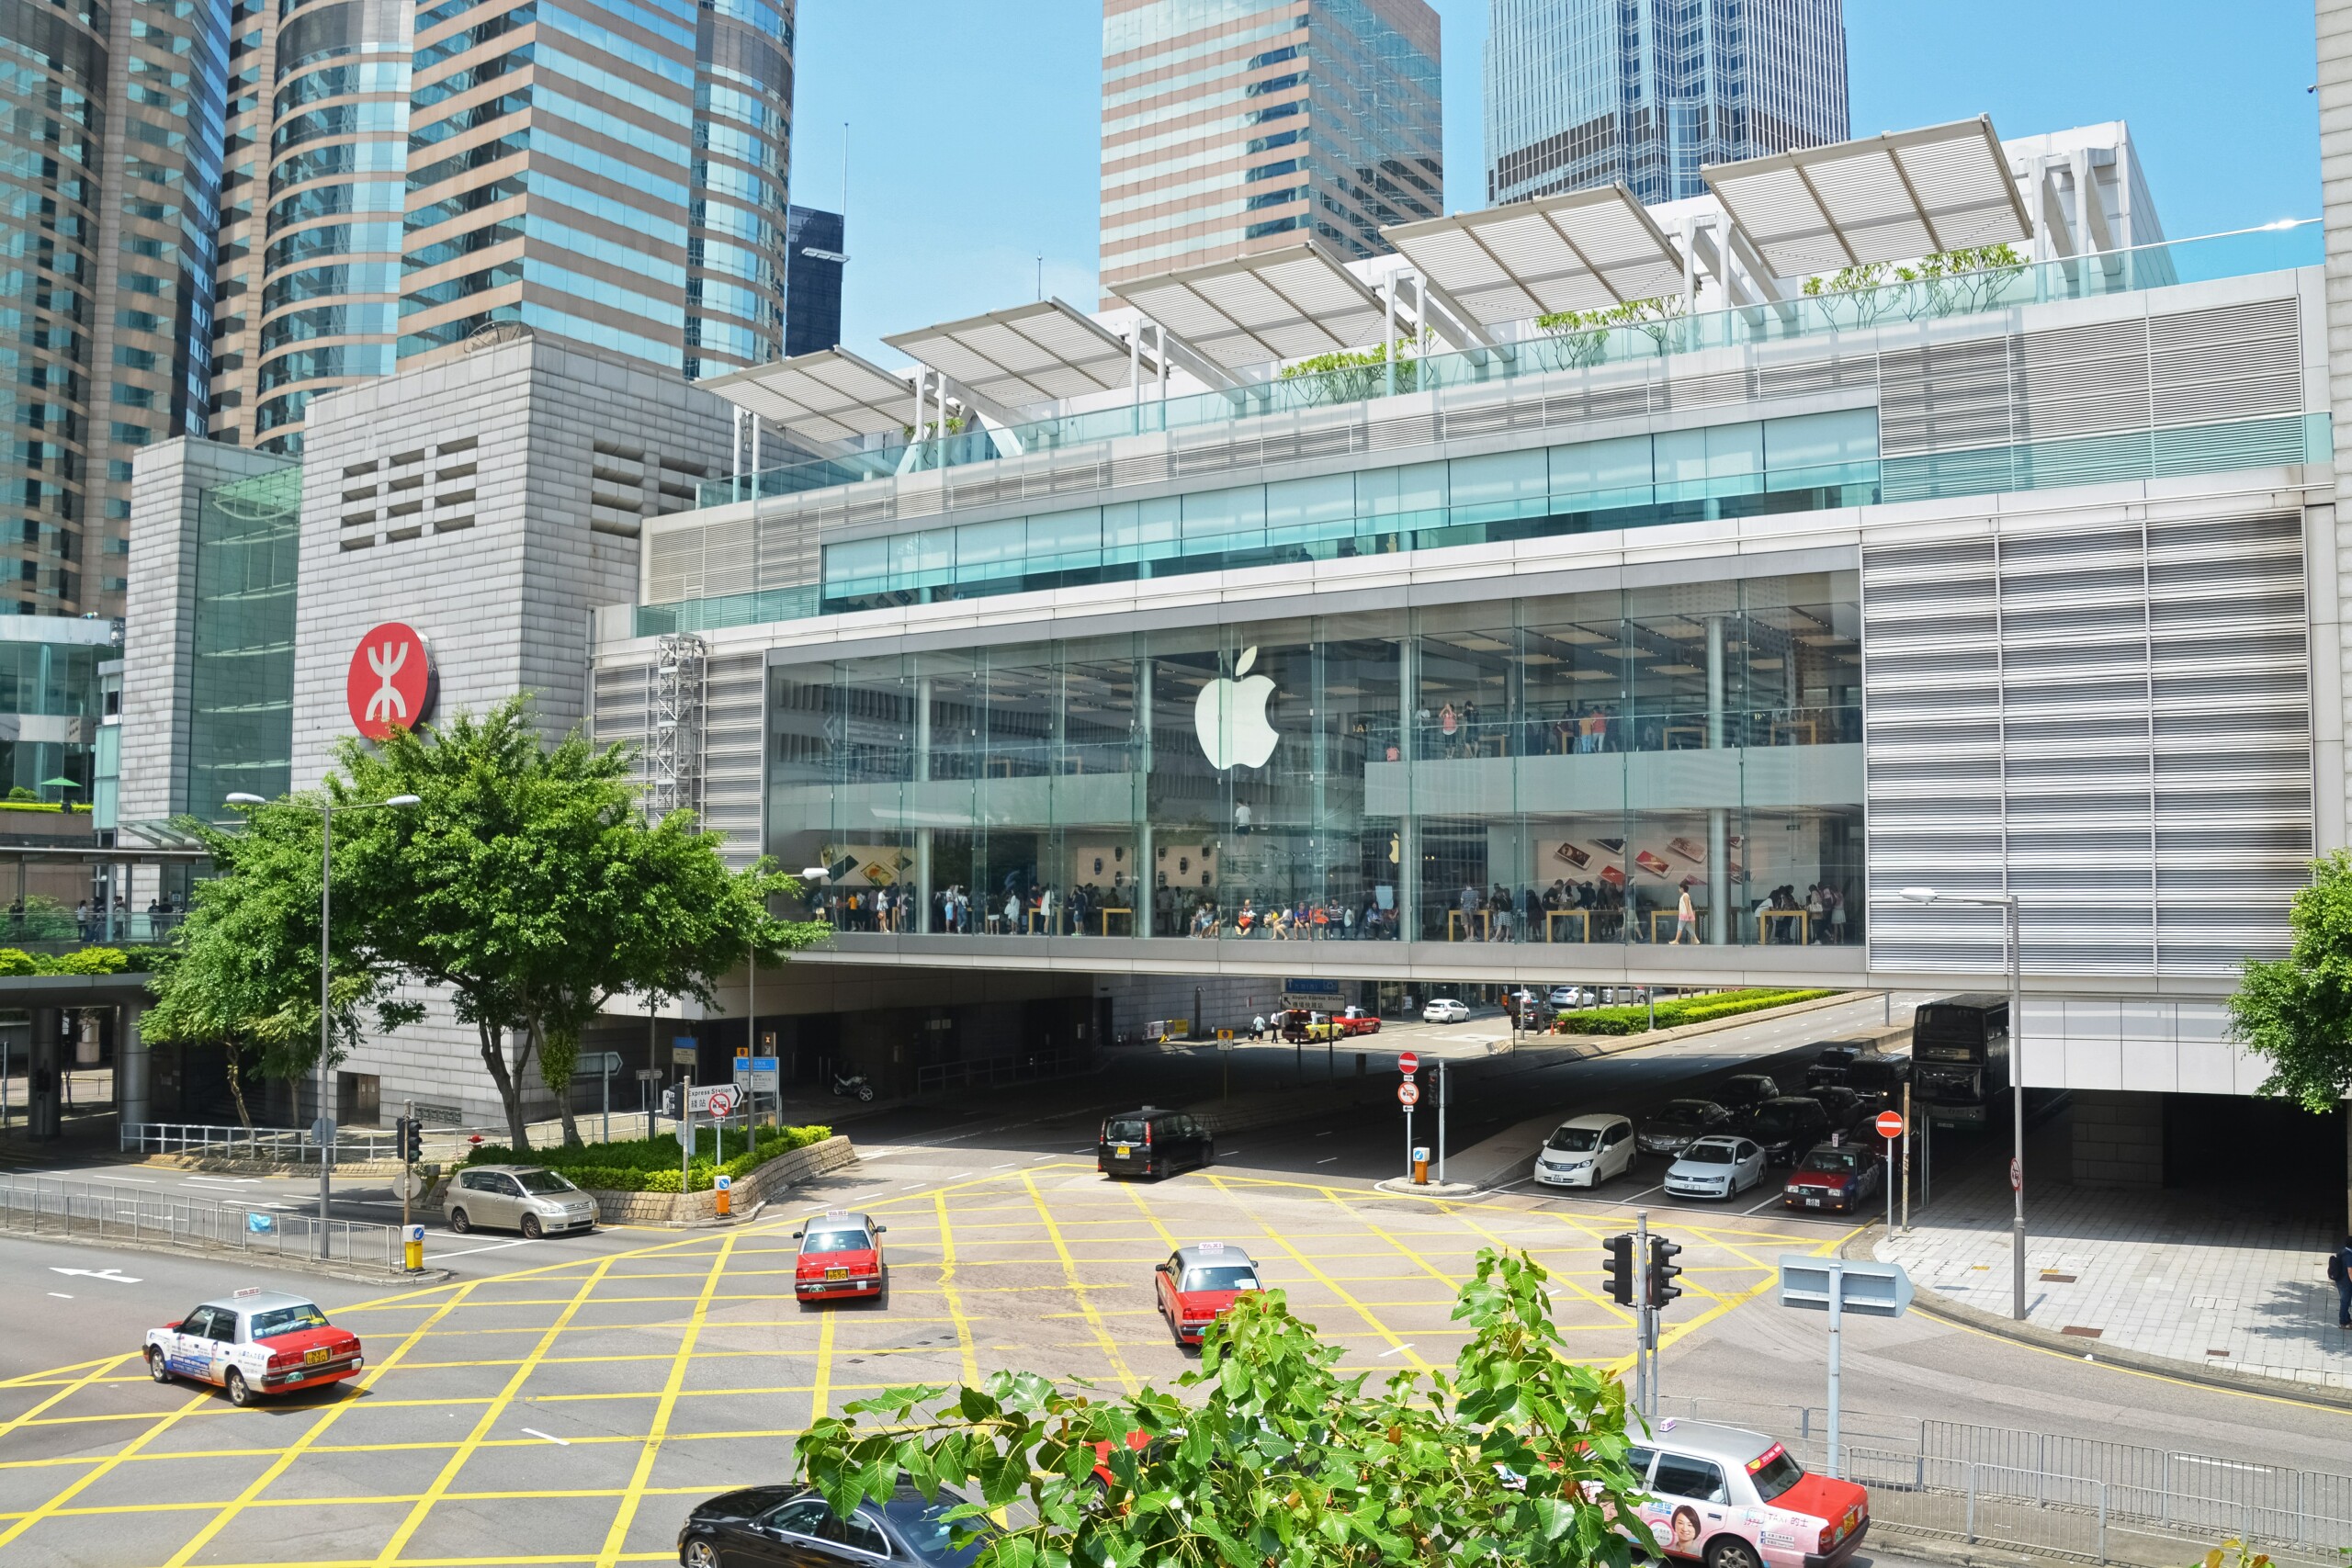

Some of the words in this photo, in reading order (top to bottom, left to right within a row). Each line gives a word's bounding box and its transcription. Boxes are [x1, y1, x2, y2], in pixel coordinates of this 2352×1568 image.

[688, 1089, 710, 1097] Express
[711, 1086, 732, 1094] Station
[1768, 1513, 1788, 1523] TAXI
[1790, 1517, 1808, 1528] 的士
